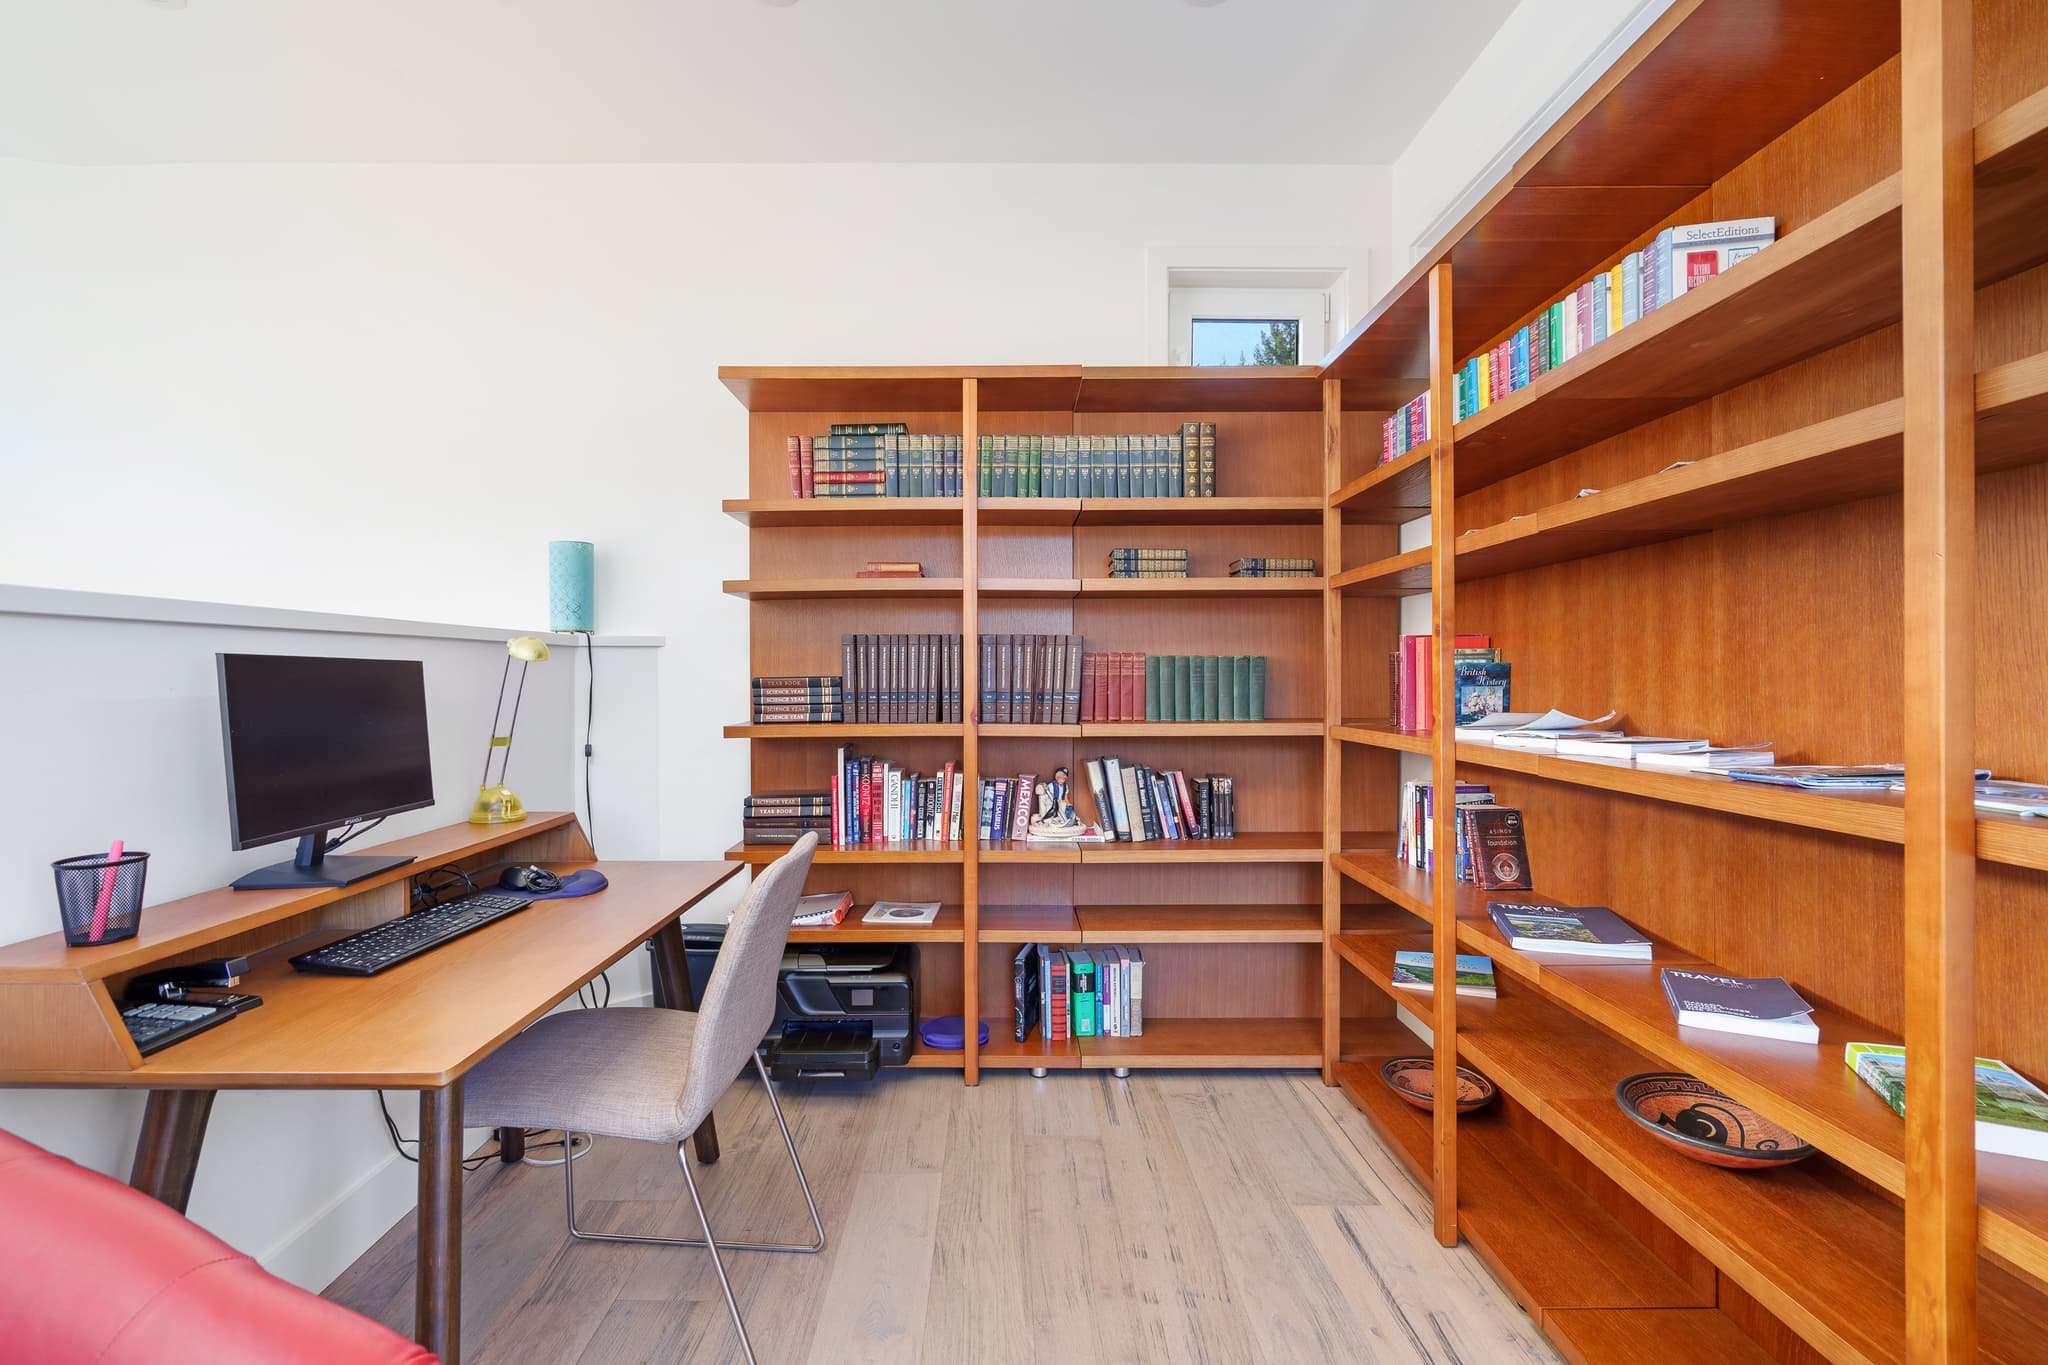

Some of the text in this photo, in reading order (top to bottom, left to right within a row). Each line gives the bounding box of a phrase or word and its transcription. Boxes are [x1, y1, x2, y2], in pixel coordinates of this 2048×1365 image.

[1686, 226, 1760, 241] SelectEditions
[1461, 666, 1487, 676] British
[1478, 676, 1507, 688] History
[861, 773, 871, 806] KOONTZ
[890, 774, 899, 809] GANDHI
[926, 794, 934, 817] KOONTZ
[1016, 779, 1031, 827] MEXICO
[994, 796, 1003, 831] THESAURUS
[1496, 903, 1564, 913] TRAVEL
[1669, 970, 1744, 986] TRAVEL
